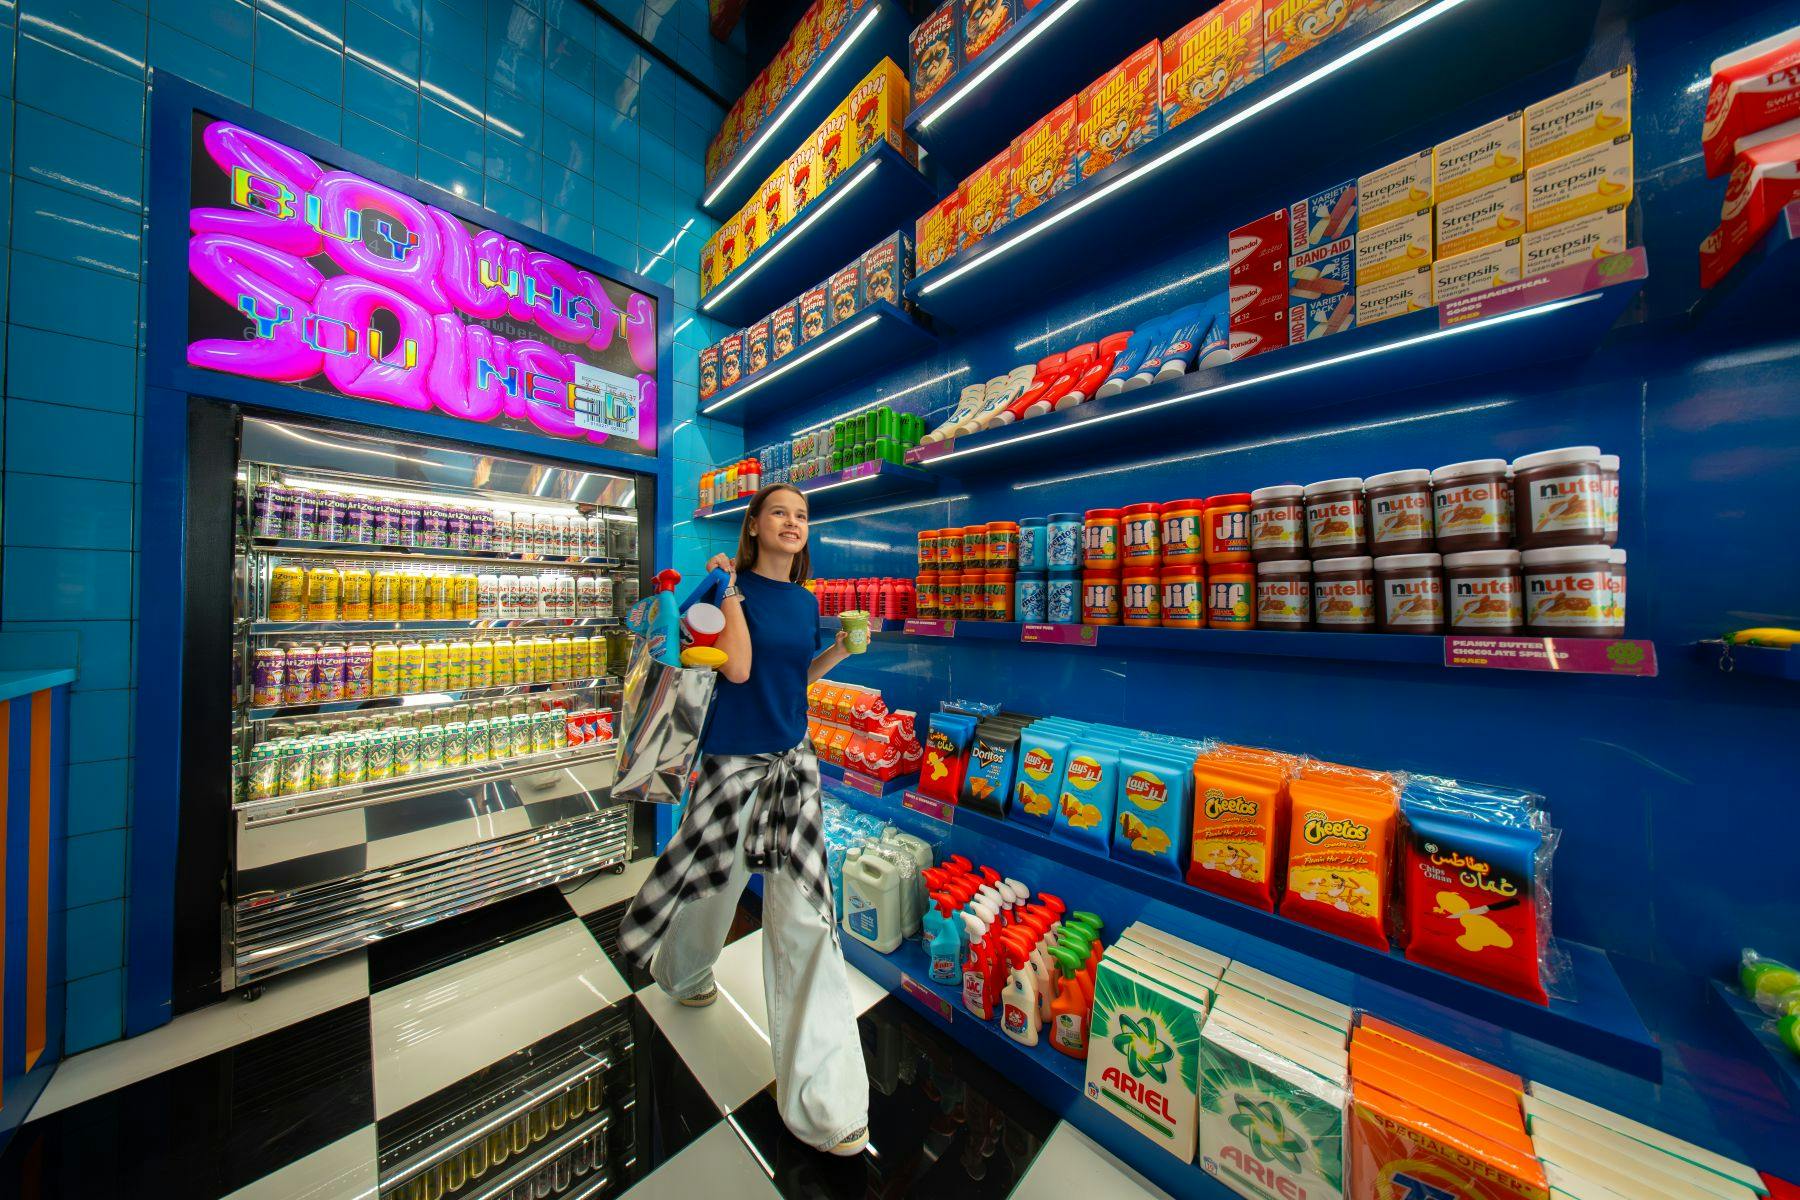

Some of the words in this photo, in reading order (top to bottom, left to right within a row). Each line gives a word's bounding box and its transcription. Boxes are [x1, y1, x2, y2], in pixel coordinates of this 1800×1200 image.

[1530, 100, 1603, 134] Strepsils
[1440, 141, 1501, 170] Strepsils
[1362, 175, 1415, 201] Strepsils
[1533, 165, 1607, 196] Strepsils
[1312, 184, 1351, 205] VARIETY
[1293, 202, 1307, 250] BAND-AID
[1442, 201, 1504, 229] Strepsils
[231, 166, 420, 261] BUY
[480, 259, 636, 339] WHAT
[867, 247, 892, 264] Karma
[1231, 238, 1258, 254] Panadol
[1295, 238, 1351, 268] BAND-AID
[1360, 232, 1413, 256] Strepsils
[1528, 232, 1600, 261] Strepsils
[866, 255, 894, 274] Krispies
[1341, 254, 1350, 286] VARIETY
[1438, 264, 1500, 288] Strepsils
[1231, 288, 1258, 303] Panadol
[1310, 293, 1349, 311] VARIETY
[1360, 289, 1413, 310] Strepsils
[1446, 277, 1550, 310] PHARMACEUTICAL
[1446, 302, 1482, 316] GOODS
[458, 310, 578, 354] trawberries
[1292, 306, 1306, 344] AND-AID
[1231, 337, 1258, 350] Panadol
[238, 295, 418, 370] YOU
[477, 358, 637, 424] NEED
[254, 491, 285, 503] AriZon
[1540, 476, 1603, 497] nutel
[347, 502, 374, 511] AriZo
[423, 509, 448, 518] AriZon
[1377, 492, 1433, 513] nutell
[448, 513, 471, 521] AriZo
[1085, 526, 1113, 550] Jif
[1123, 520, 1157, 546] Jif
[1162, 517, 1195, 545] Jif
[1022, 585, 1047, 608] mento
[1050, 583, 1072, 602] ntos
[1085, 585, 1116, 608] Jif
[1124, 584, 1157, 608] Jif
[1163, 583, 1197, 609] Jif
[1209, 583, 1245, 609] Jif
[1392, 577, 1441, 595] nutel
[1457, 575, 1522, 595] nutell
[1453, 640, 1497, 648] PEANUT
[1498, 641, 1543, 649] BUTTER
[1453, 648, 1516, 657] CHOCOLATE
[257, 659, 285, 668] AriZ
[286, 658, 316, 667] AriZon
[972, 747, 1004, 763] Doritos
[1205, 797, 1259, 819] Cheetos
[1304, 819, 1369, 844] Cheetos
[1419, 862, 1446, 876] Chips
[1423, 870, 1452, 884] Oman
[1101, 1066, 1177, 1125] ARIEL
[1374, 1113, 1456, 1159] SPECIAL
